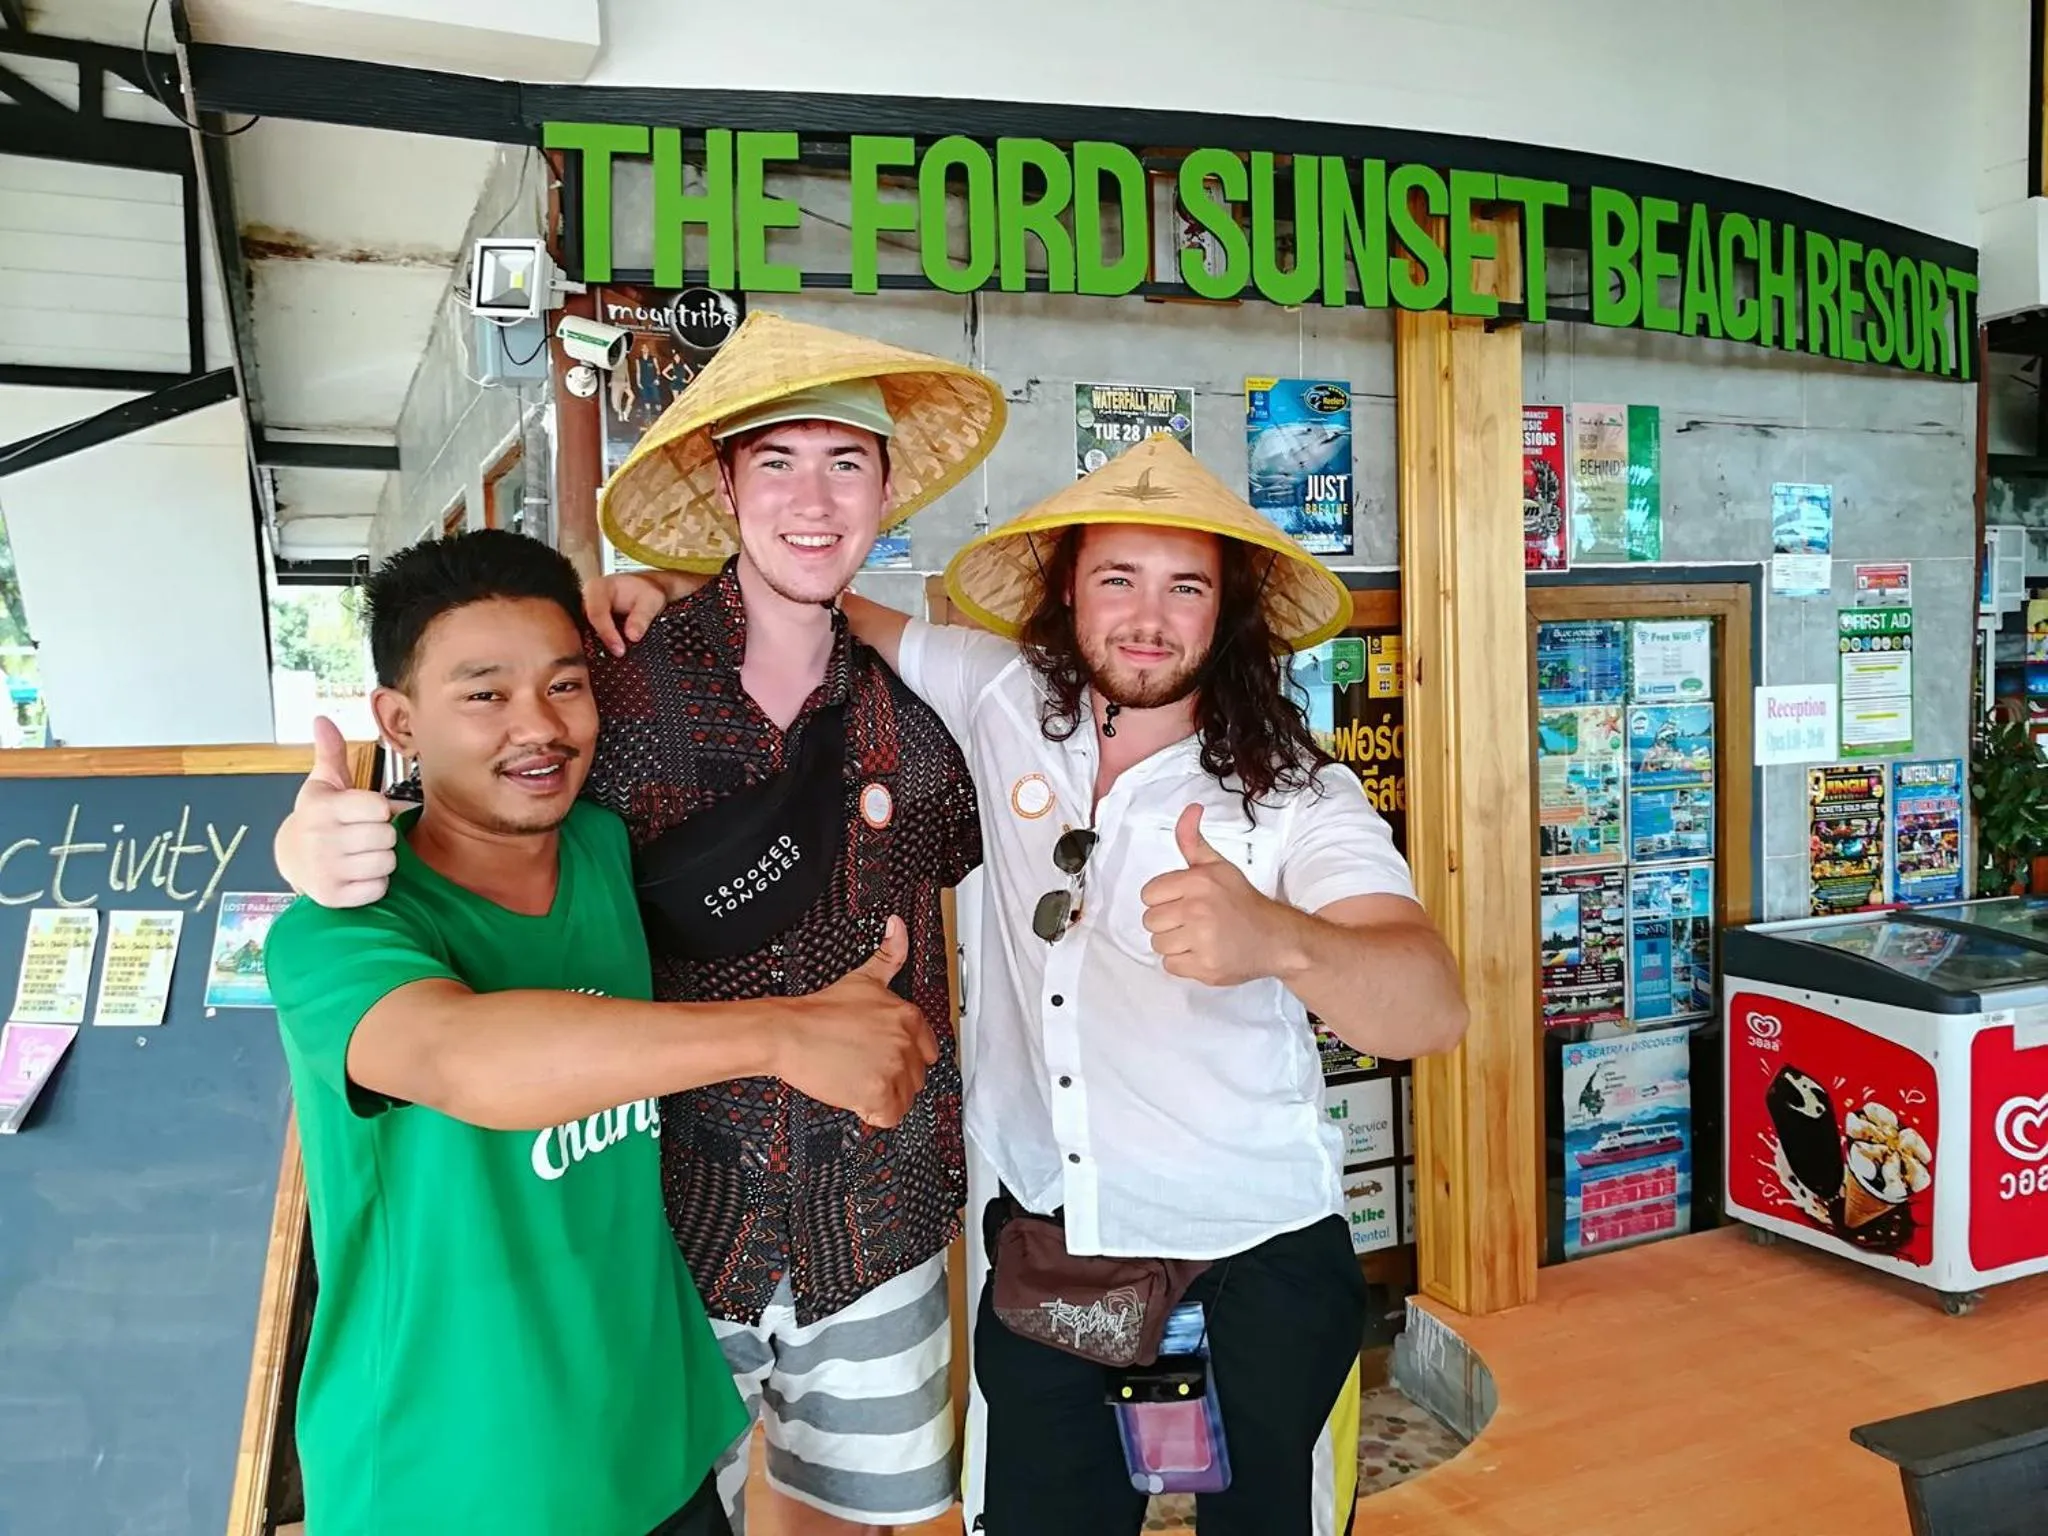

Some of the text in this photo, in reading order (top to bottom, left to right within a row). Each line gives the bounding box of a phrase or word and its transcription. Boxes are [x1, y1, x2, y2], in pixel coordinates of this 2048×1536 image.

[543, 121, 1978, 382] THE FORD SUNSET BEACH RESORT
[1092, 390, 1177, 413] WATERFALL PARTY
[1094, 423, 1120, 440] TUE
[1122, 425, 1140, 441] 28
[1305, 474, 1348, 502] JUST
[1305, 503, 1349, 515] BREATHE
[1853, 612, 1911, 630] FIRST AID
[1767, 695, 1826, 724] Reception
[704, 835, 793, 907] CROOKED
[711, 846, 801, 919] TONGUES
[1348, 1119, 1388, 1137] Service
[1353, 1226, 1391, 1245] Rental
